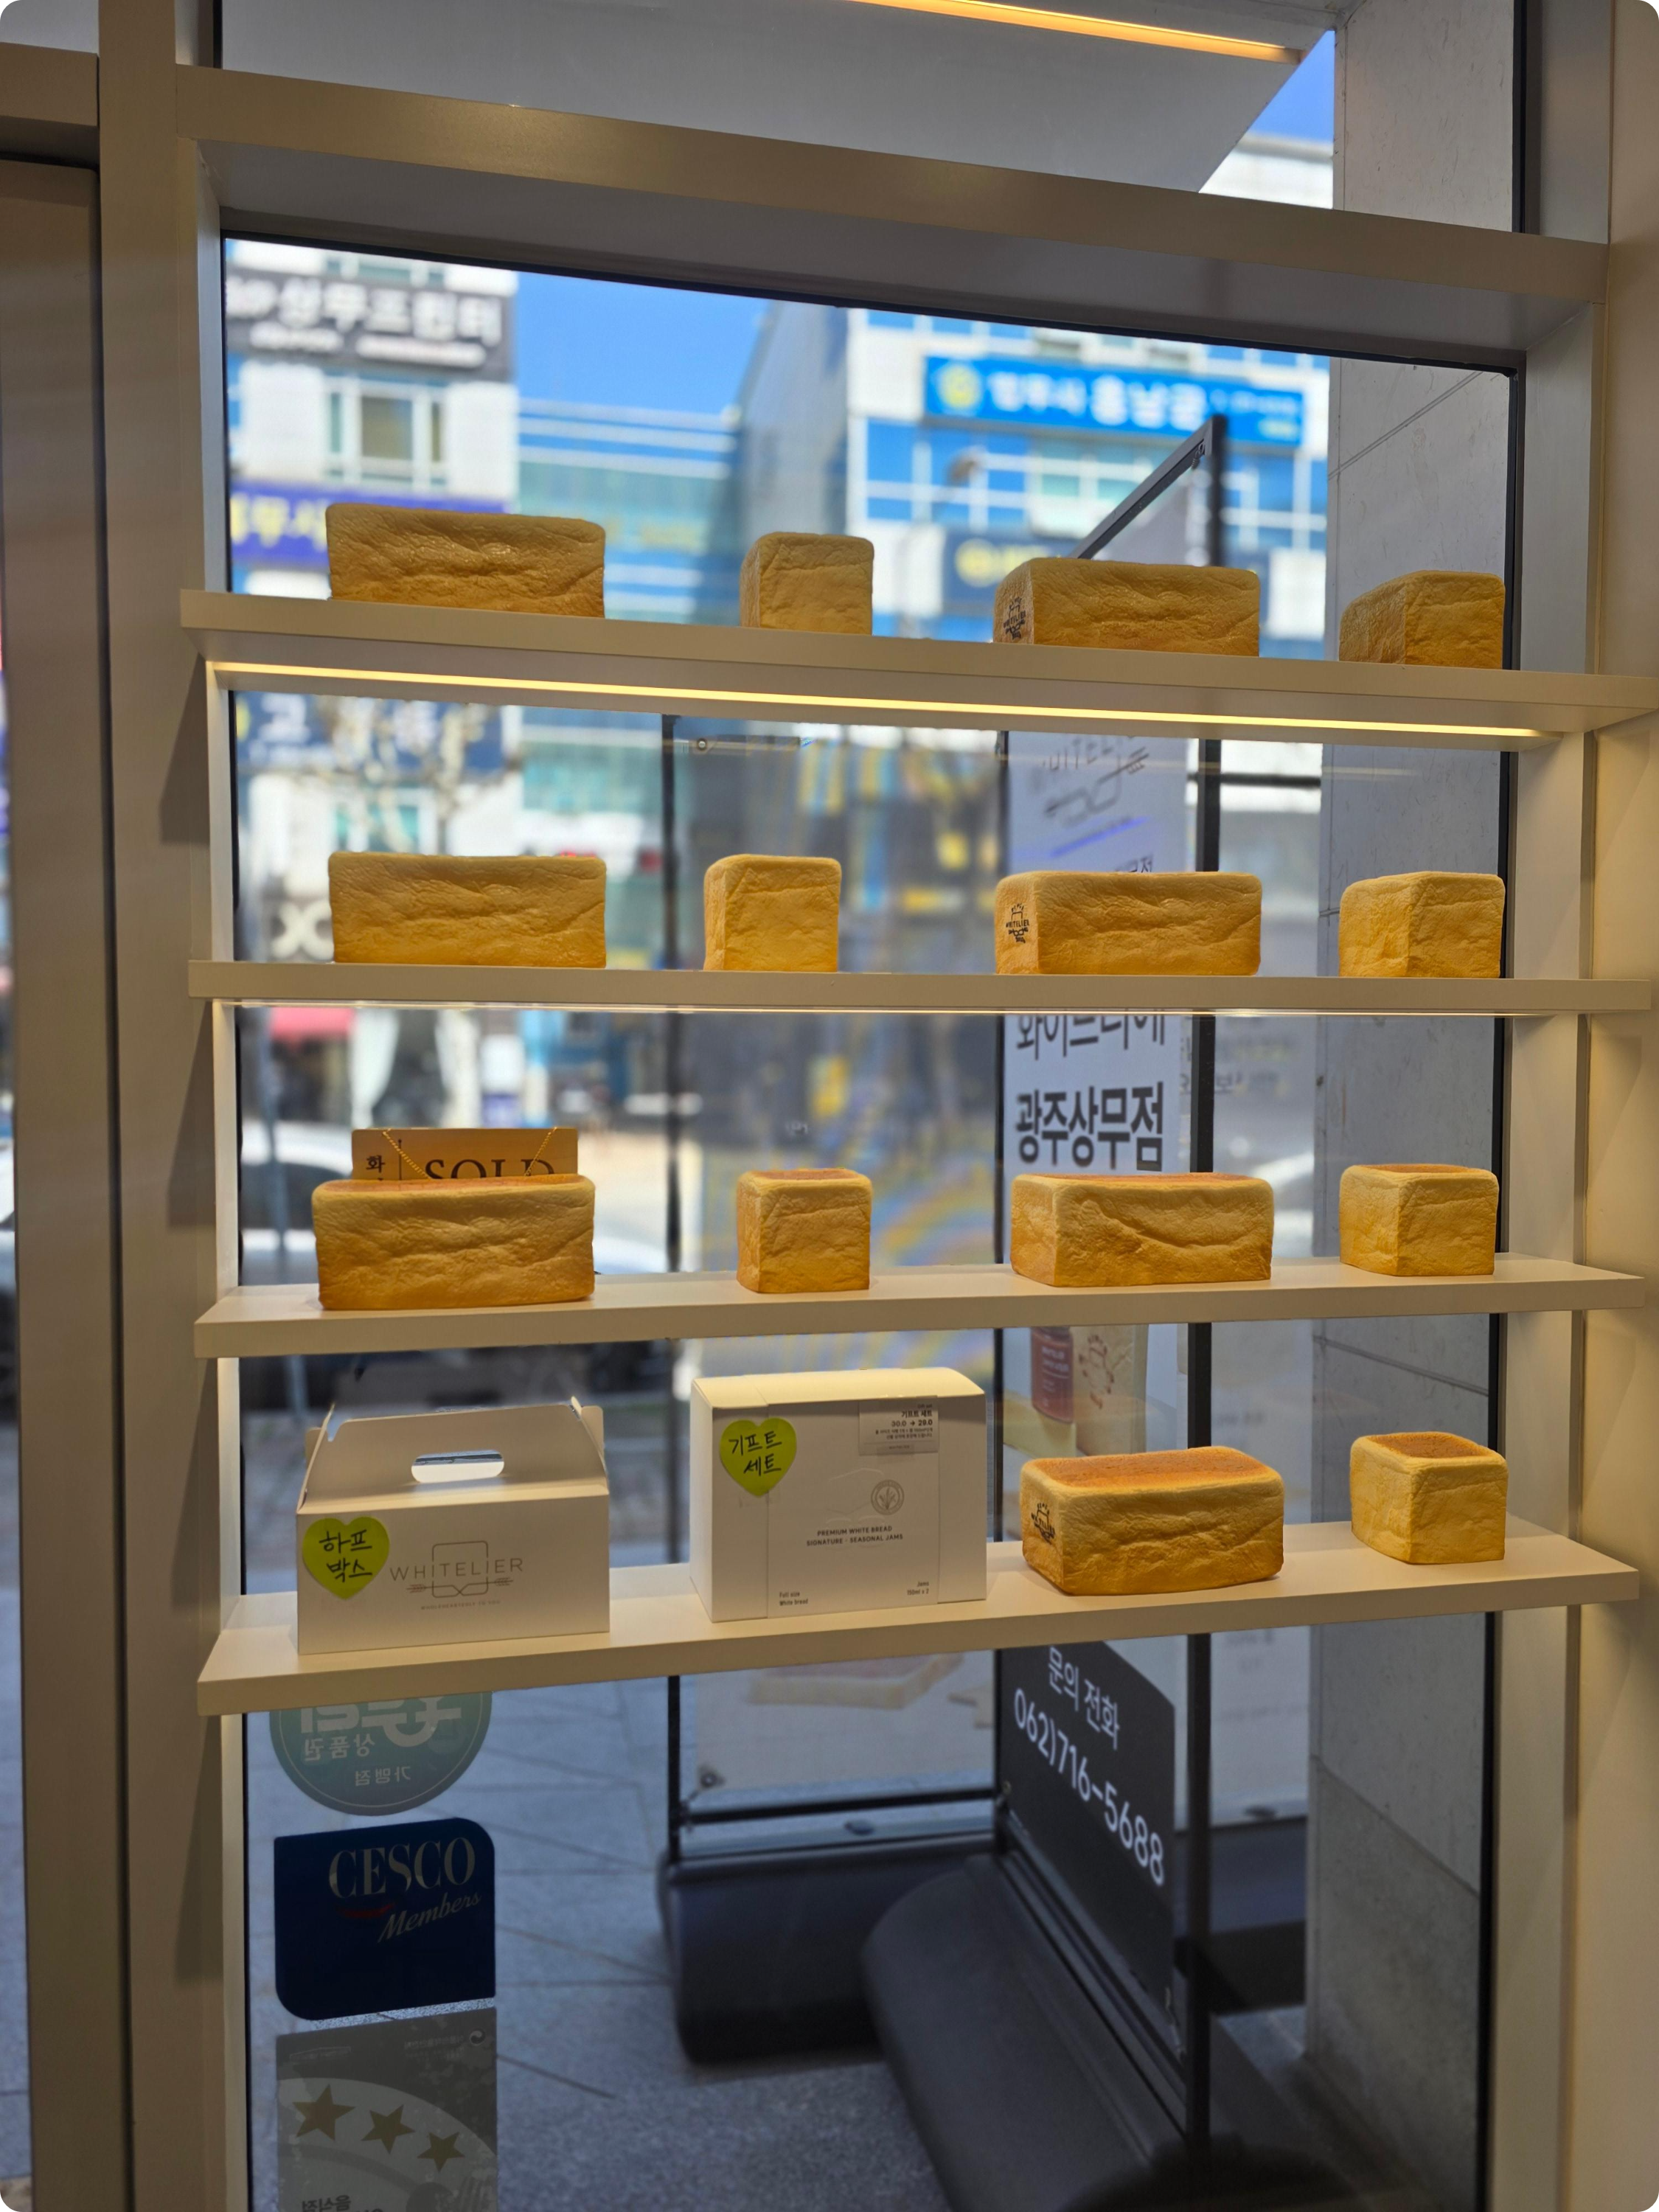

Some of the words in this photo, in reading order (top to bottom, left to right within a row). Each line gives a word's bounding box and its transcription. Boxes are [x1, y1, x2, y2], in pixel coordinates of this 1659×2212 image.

[1016, 1081, 1164, 1172] 광주상무점
[901, 1410, 919, 1418] 기프트
[728, 1431, 782, 1456] 기프트
[743, 1453, 782, 1476] 세트
[319, 1529, 372, 1553] 하프
[807, 1538, 844, 1547] SIGNATURE
[850, 1535, 884, 1543] SEASONAL
[817, 1528, 847, 1537] PREMIUM
[849, 1526, 869, 1534] WHITE
[327, 1557, 372, 1582] 박스
[389, 1557, 524, 1582] WHITELIER
[1048, 1646, 1079, 1712] 문의
[1085, 1678, 1120, 1750] 전화
[1015, 1688, 1164, 1887] 062)716-5688
[329, 1837, 476, 1899] CESCO
[378, 1891, 481, 1944] Members
